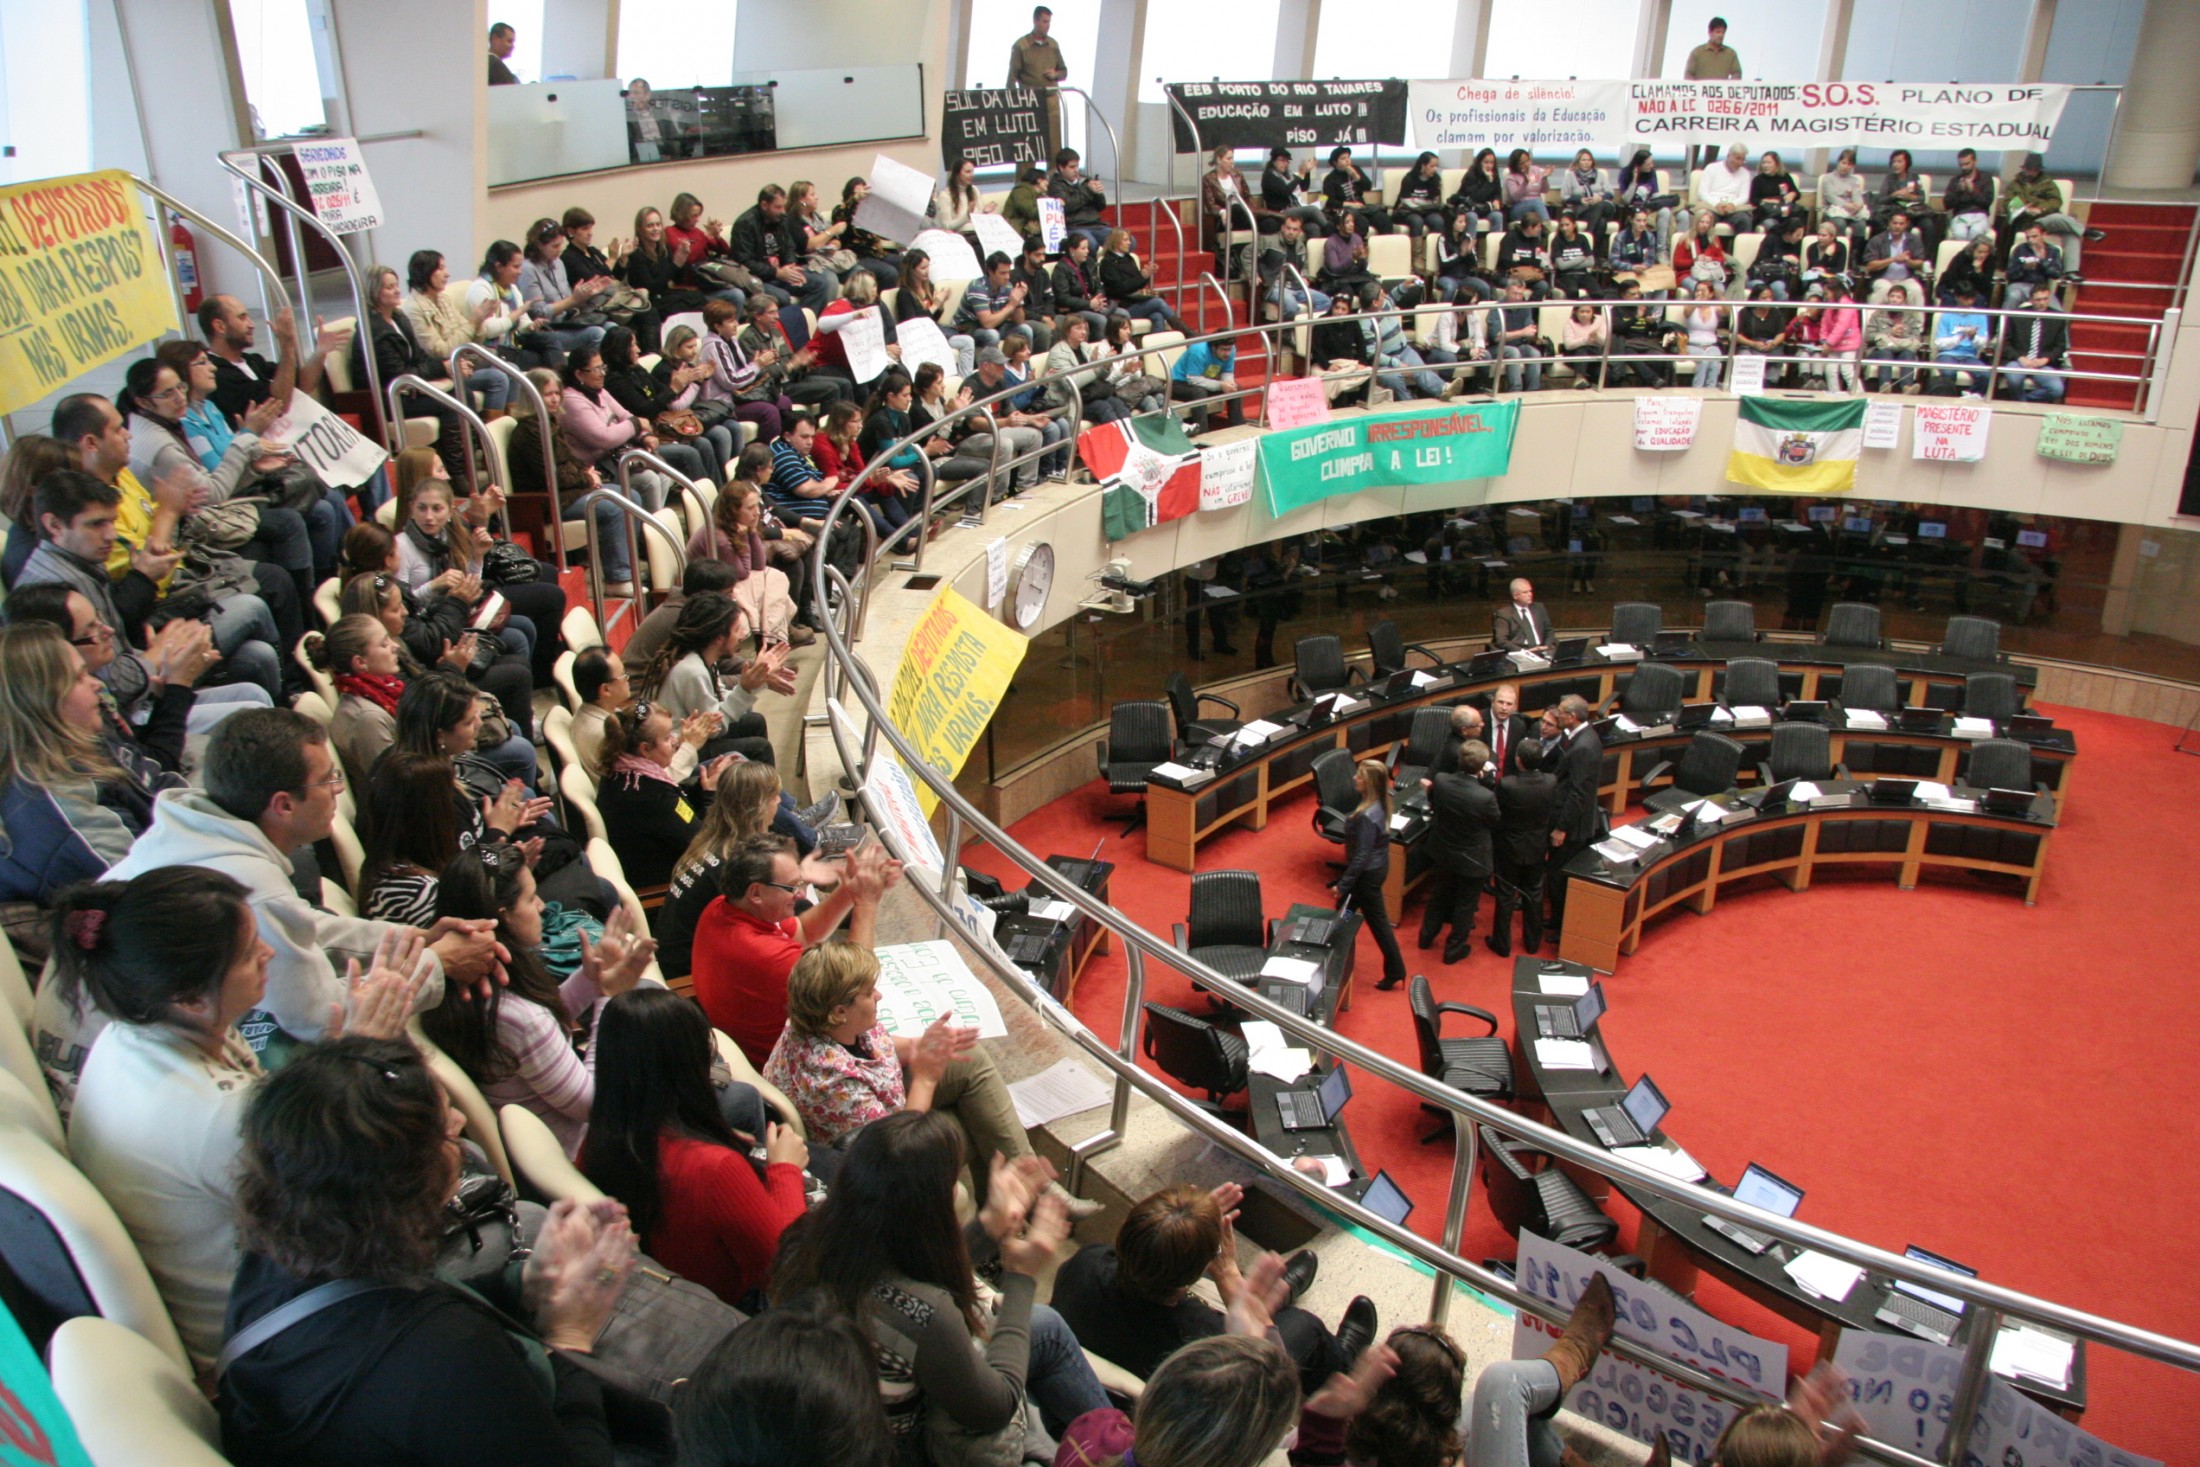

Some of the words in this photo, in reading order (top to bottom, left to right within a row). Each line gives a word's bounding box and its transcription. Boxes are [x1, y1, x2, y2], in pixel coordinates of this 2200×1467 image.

[1184, 84, 1212, 97] EEB
[1218, 84, 1261, 97] PORTO
[1269, 83, 1289, 96] DO
[1294, 83, 1317, 95] RIO
[1325, 82, 1383, 95] TAVARES
[1457, 86, 1497, 104] Chega
[1505, 86, 1520, 99] de
[1632, 84, 1697, 99] CLAMAMOS
[1702, 86, 1723, 99] AOS
[1802, 84, 1880, 108] S.O.S.
[1902, 89, 1993, 104] PLANO
[2008, 88, 2044, 101] DE
[946, 91, 978, 112] SUL
[982, 90, 1003, 108] DA
[1005, 89, 1039, 108] ILHA
[1638, 99, 1665, 114] NÃO
[1682, 99, 1696, 112] LC
[1198, 102, 1270, 120] EDUCAÇÃO
[1284, 105, 1302, 117] EM
[1426, 109, 1442, 123] Os
[1449, 108, 1525, 126] profissionais
[1533, 108, 1546, 122] da
[1553, 108, 1606, 125] Educação
[962, 116, 987, 138] EM
[1635, 116, 1760, 133] CARREIRA
[1770, 113, 1923, 134] MAGISTÉRIO
[1931, 122, 2052, 140] ESTADUAL
[1436, 129, 1485, 143] clamam
[1494, 131, 1514, 148] por
[1523, 129, 1594, 145] valorização.
[963, 144, 1004, 166] PISO
[328, 166, 346, 177] PISO
[348, 164, 362, 176] NA
[16, 243, 75, 316] DARÁ
[19, 326, 68, 387] NAS
[56, 298, 134, 365] URNAS.
[1655, 426, 1690, 436] EDUCAÇÃO
[1924, 421, 1973, 436] PRESENTE
[1291, 427, 1356, 461] GOVERNO
[1936, 437, 1949, 446] NA
[1924, 447, 1956, 460] LUTA
[1321, 453, 1374, 481] CUMPRA
[1391, 451, 1401, 470] A
[933, 630, 987, 700] RESPOSTA
